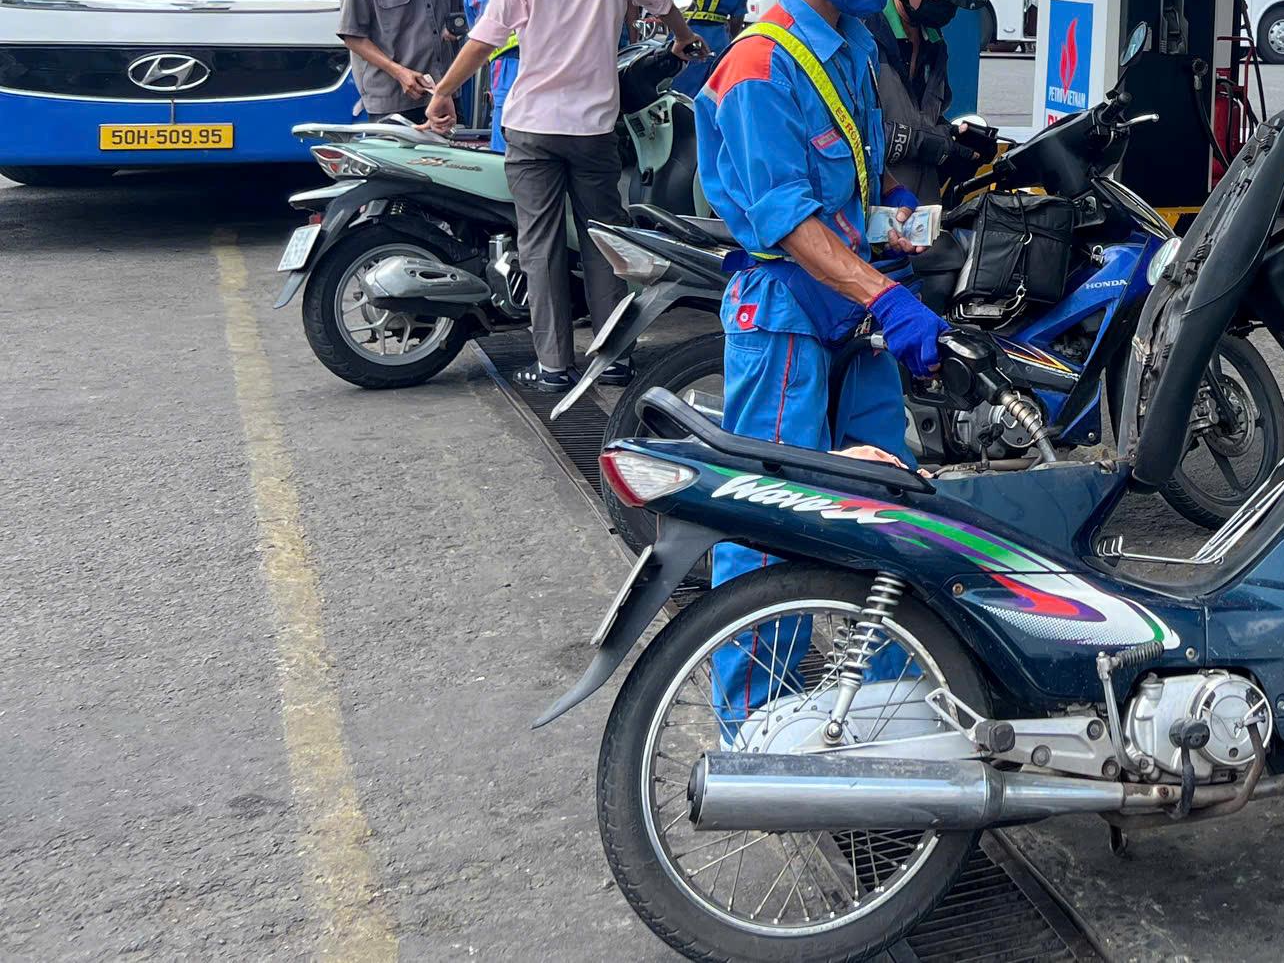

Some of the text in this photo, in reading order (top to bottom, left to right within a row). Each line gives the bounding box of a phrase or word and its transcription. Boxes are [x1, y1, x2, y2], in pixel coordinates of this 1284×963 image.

[1048, 86, 1086, 108] PETROVIETNAM
[111, 129, 203, 145] 50H-509.95
[1086, 280, 1128, 290] HONDA
[711, 475, 842, 512] Wave
